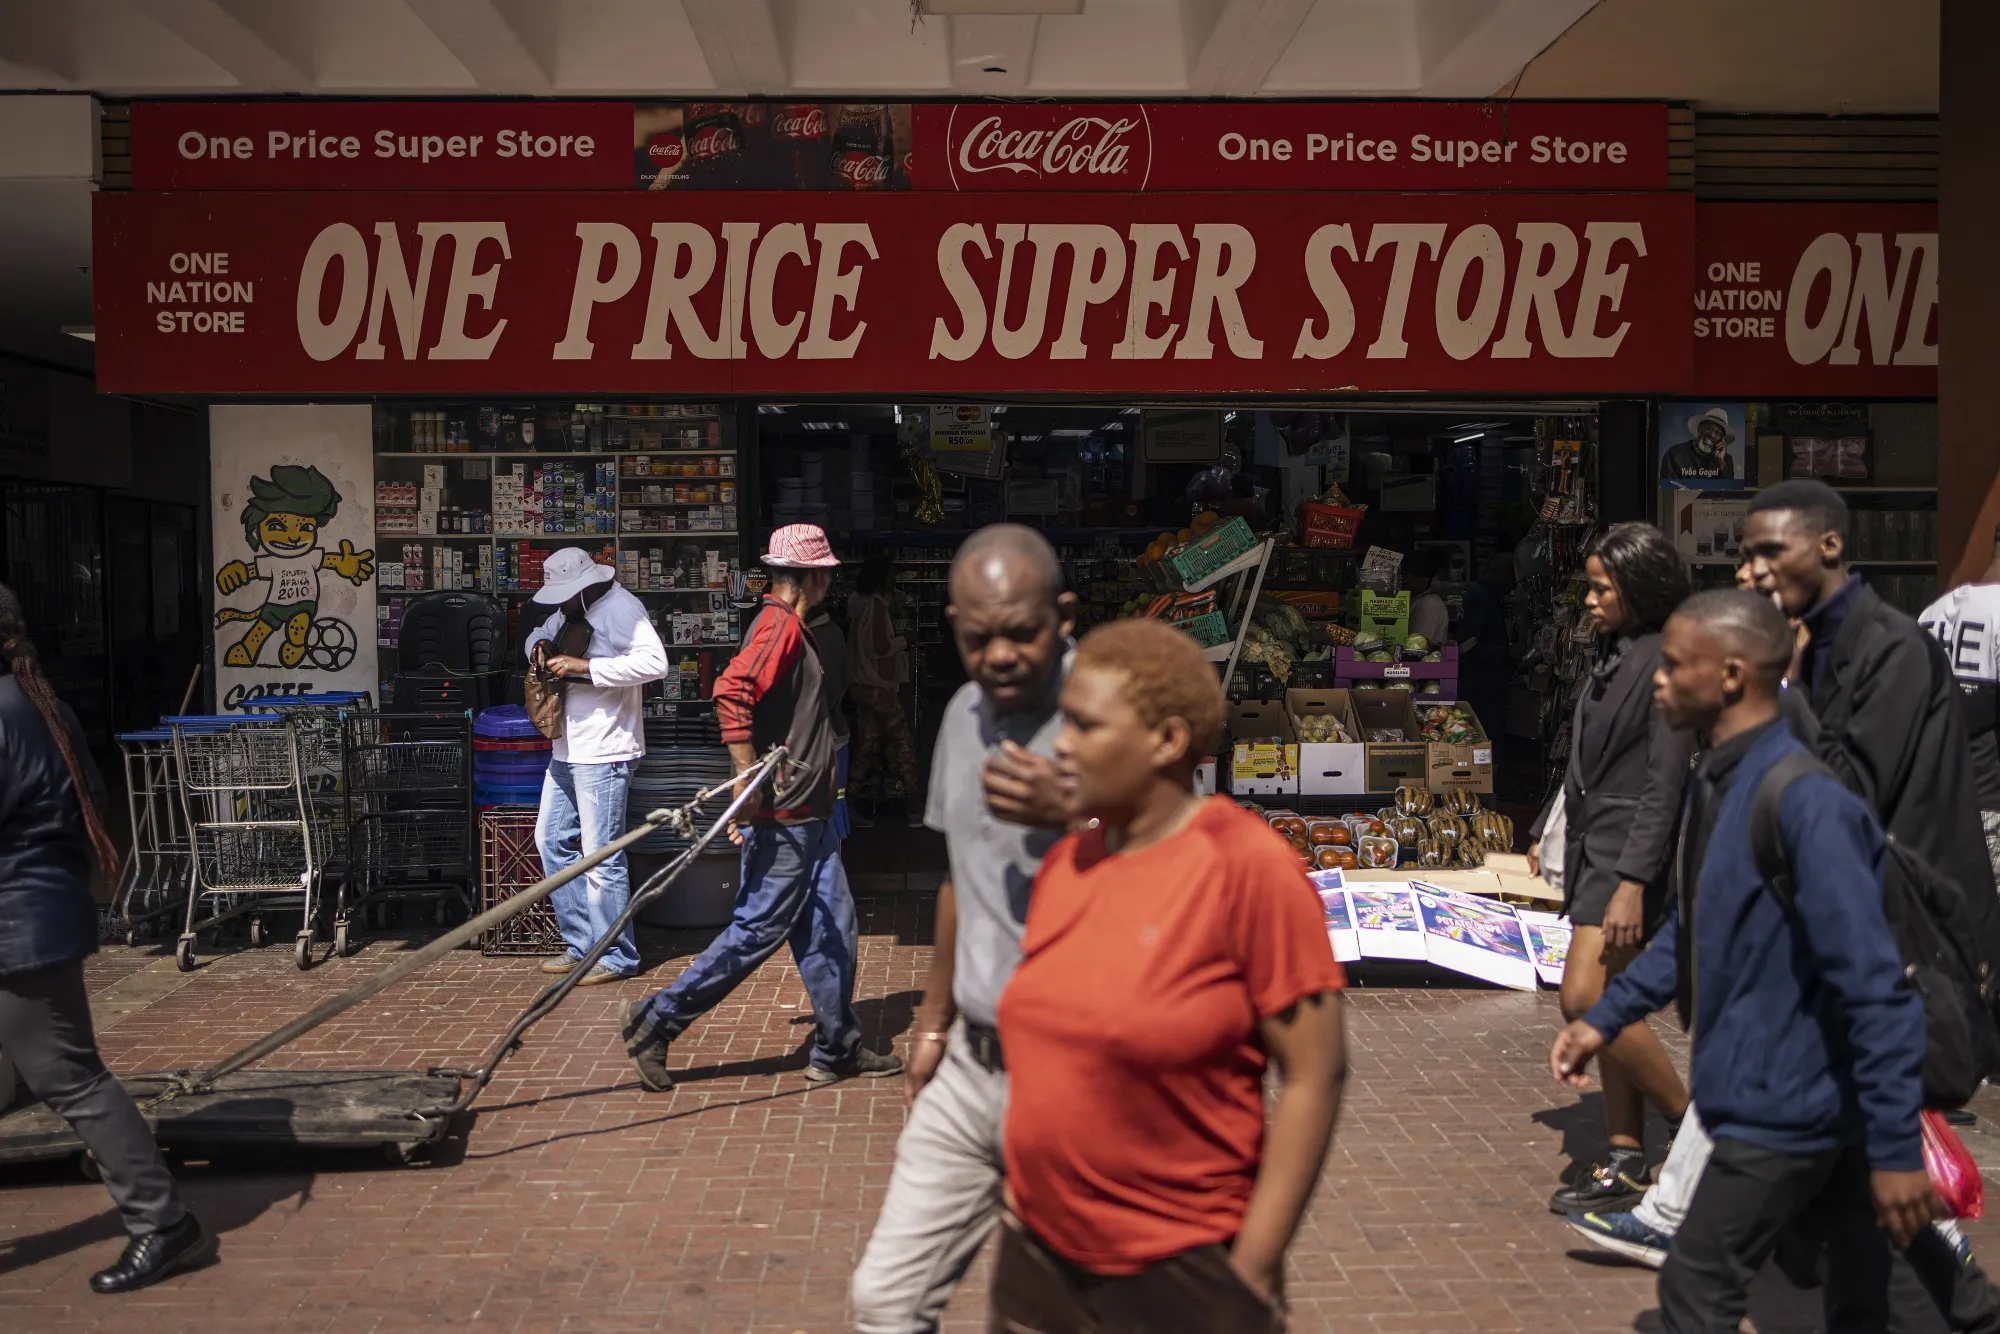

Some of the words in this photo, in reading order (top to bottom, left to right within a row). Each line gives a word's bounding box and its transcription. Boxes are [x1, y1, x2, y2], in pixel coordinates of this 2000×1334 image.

[178, 131, 254, 160] One
[269, 130, 361, 159] Price
[374, 130, 484, 164] Super
[496, 129, 595, 158] Store
[1218, 132, 1293, 161] One
[1307, 132, 1398, 162] Price
[1411, 134, 1518, 168] Super
[1530, 135, 1627, 164] Store
[170, 252, 229, 274] ONE
[1708, 262, 1761, 283] ONE
[147, 281, 253, 303] NATION
[297, 222, 512, 362] ONE
[552, 222, 880, 360] PRICE
[928, 222, 1264, 362] SUPER
[1292, 222, 1648, 360] STORE
[1693, 290, 1782, 310] NATION
[156, 311, 245, 333] STORE
[1693, 317, 1775, 338] STORE
[1681, 467, 1697, 476] Yebo
[1699, 467, 1719, 478] Gogo!
[280, 577, 310, 589] AFRICA
[281, 569, 307, 578] SOUTH
[278, 586, 310, 601] 2010
